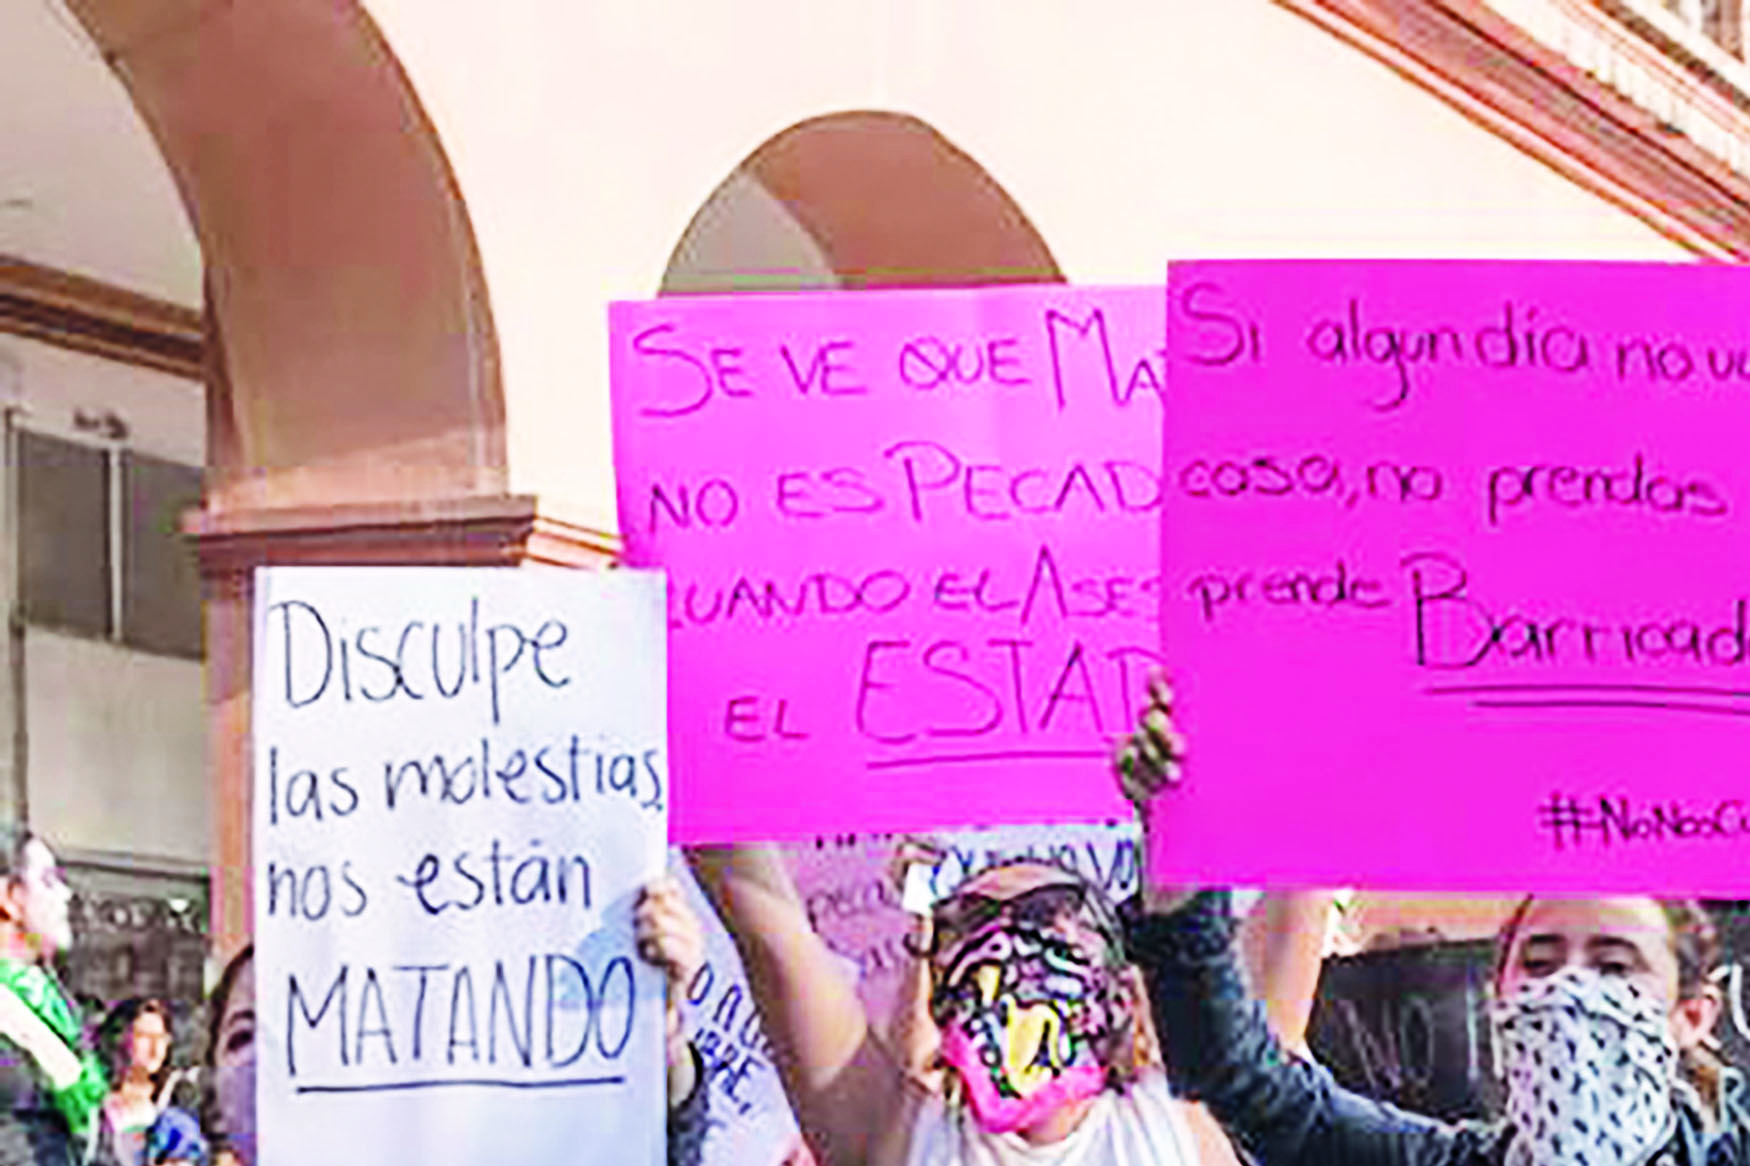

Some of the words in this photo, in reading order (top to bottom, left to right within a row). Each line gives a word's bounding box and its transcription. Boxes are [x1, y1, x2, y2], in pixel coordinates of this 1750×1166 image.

[779, 340, 868, 396] VE
[897, 335, 1033, 390] QUE
[1045, 308, 1166, 411] MA
[1183, 282, 1262, 366] Si
[650, 478, 739, 534] NO
[667, 570, 911, 631] UANDO
[269, 597, 571, 724] Disculpe
[724, 695, 808, 742] EL
[269, 747, 358, 824] las
[267, 862, 367, 920] nos
[287, 954, 637, 1076] MATANDO
